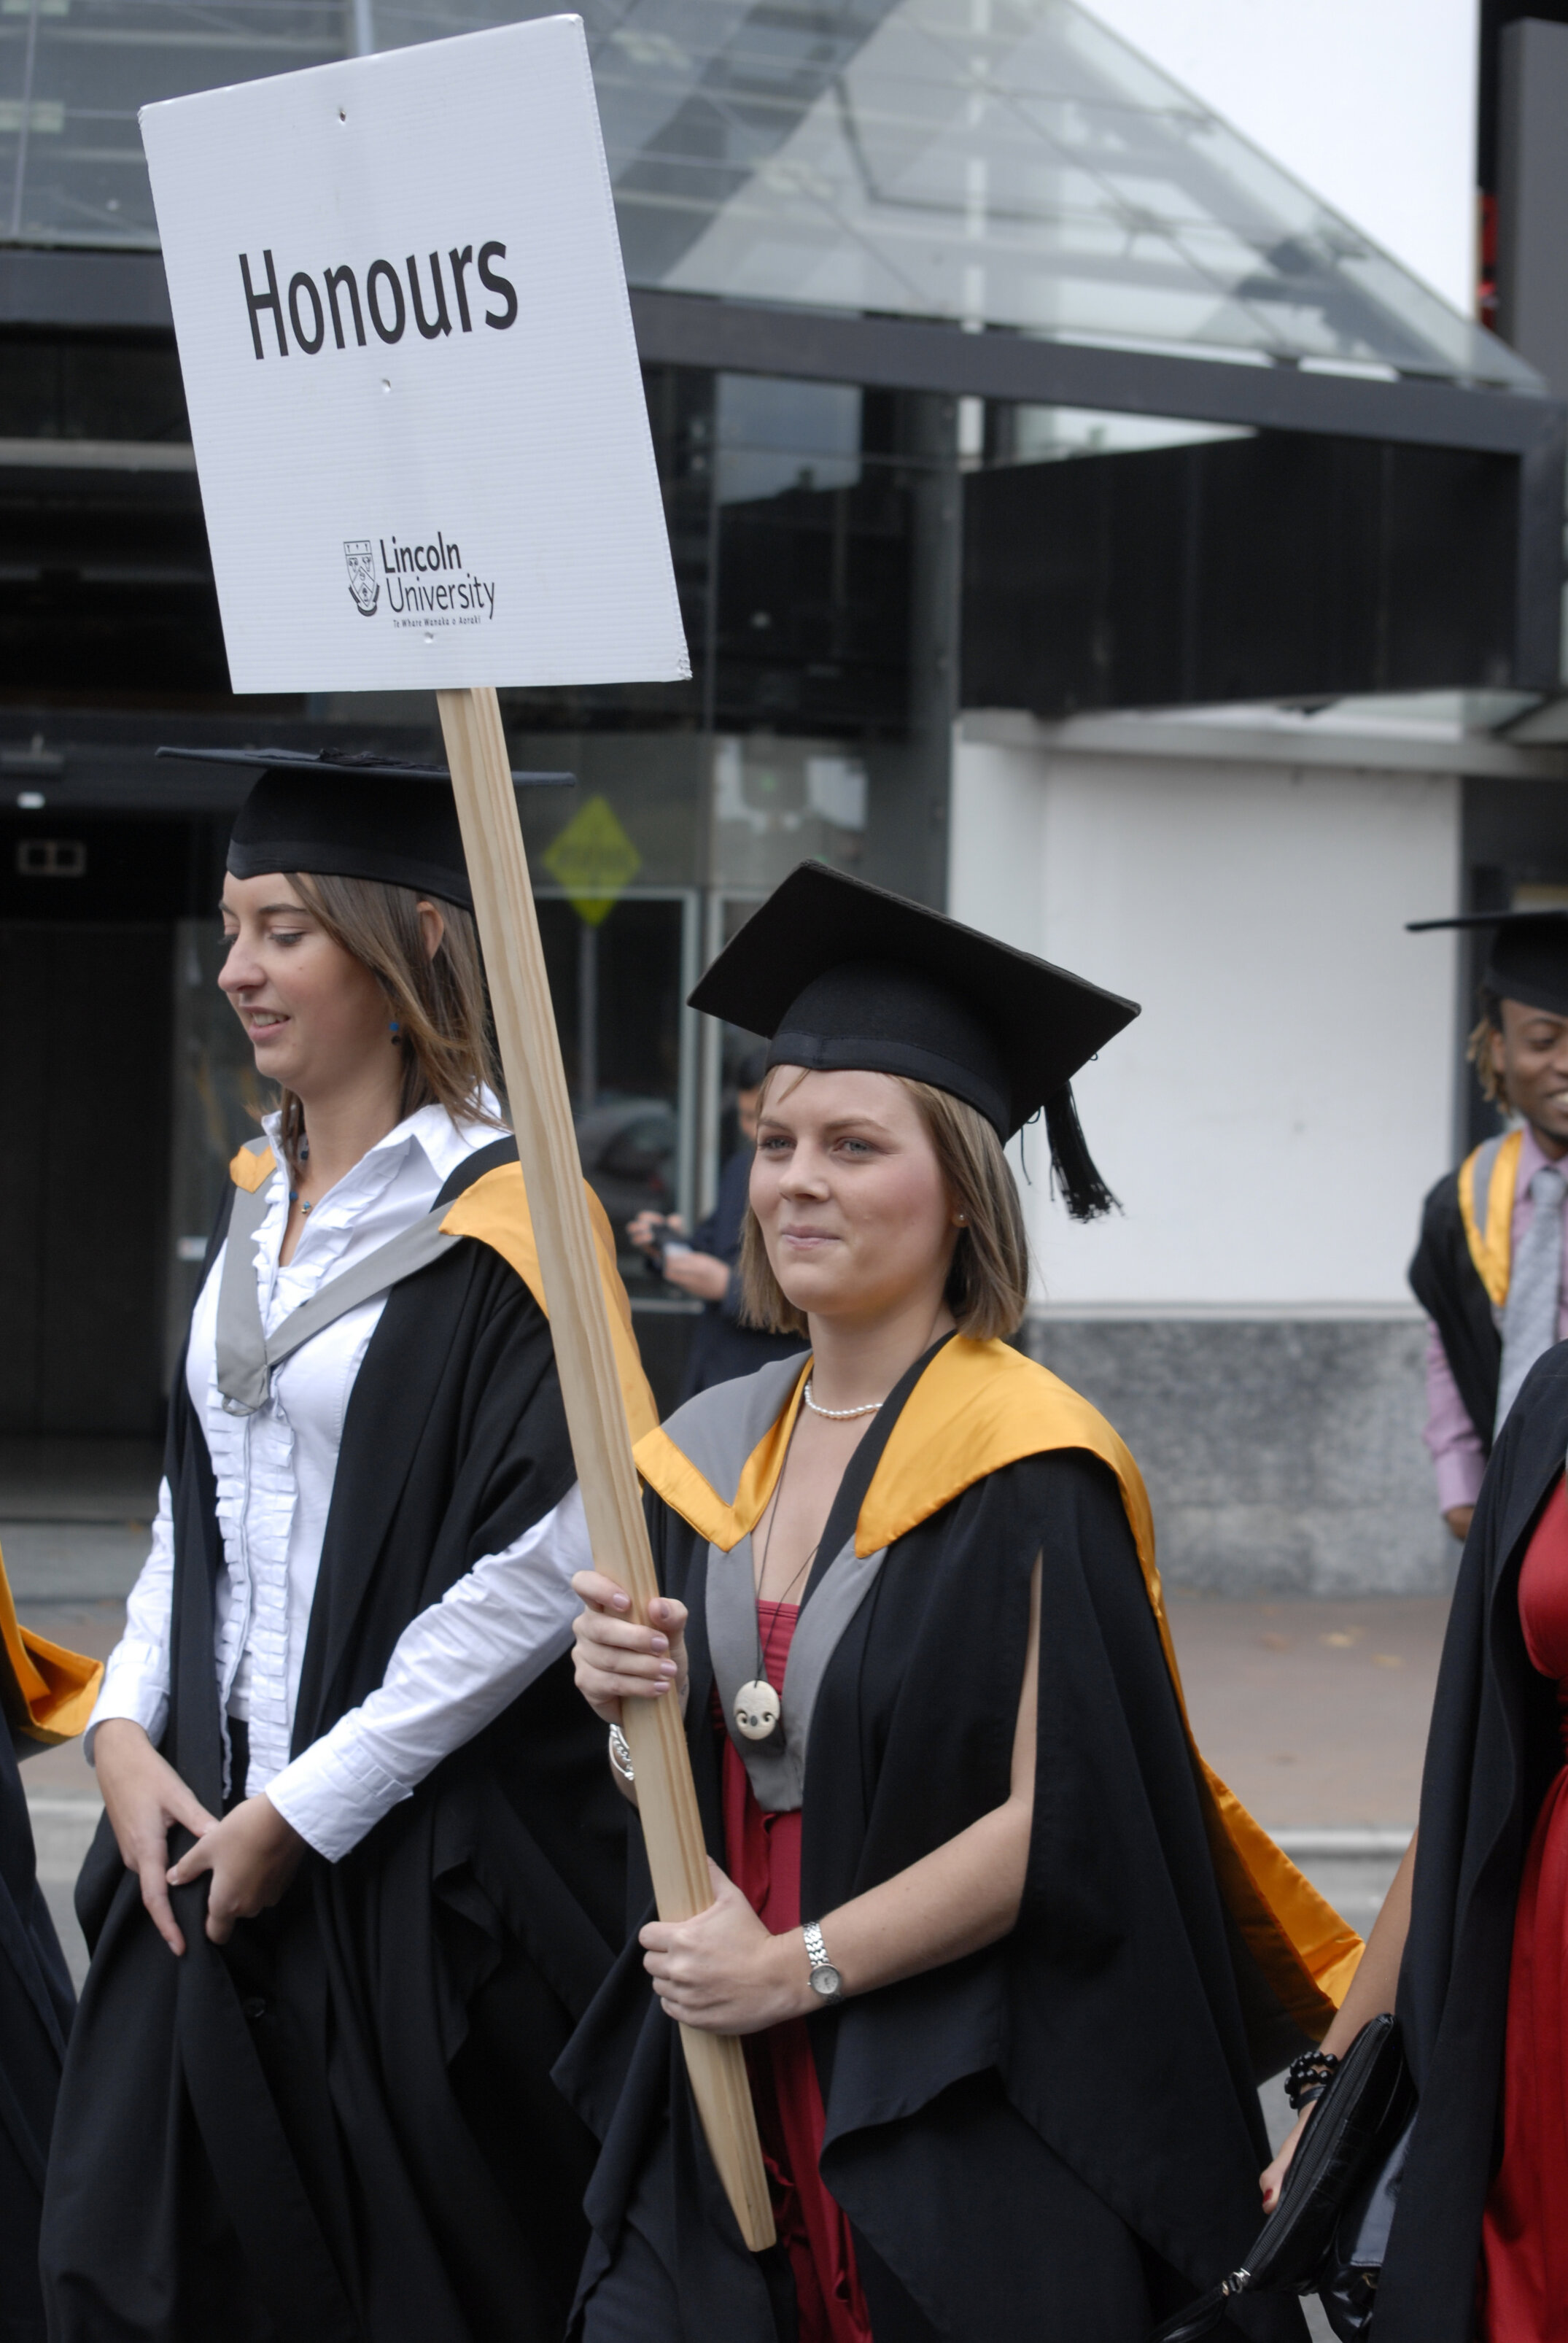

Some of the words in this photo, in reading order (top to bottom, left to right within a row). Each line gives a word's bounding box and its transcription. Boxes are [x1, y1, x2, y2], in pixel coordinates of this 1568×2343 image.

[239, 241, 517, 360] Honours
[380, 532, 461, 573] Lincoln
[387, 573, 494, 619] University
[393, 619, 400, 628] Te
[402, 618, 422, 627] Whare
[459, 615, 481, 625] Aoraki
